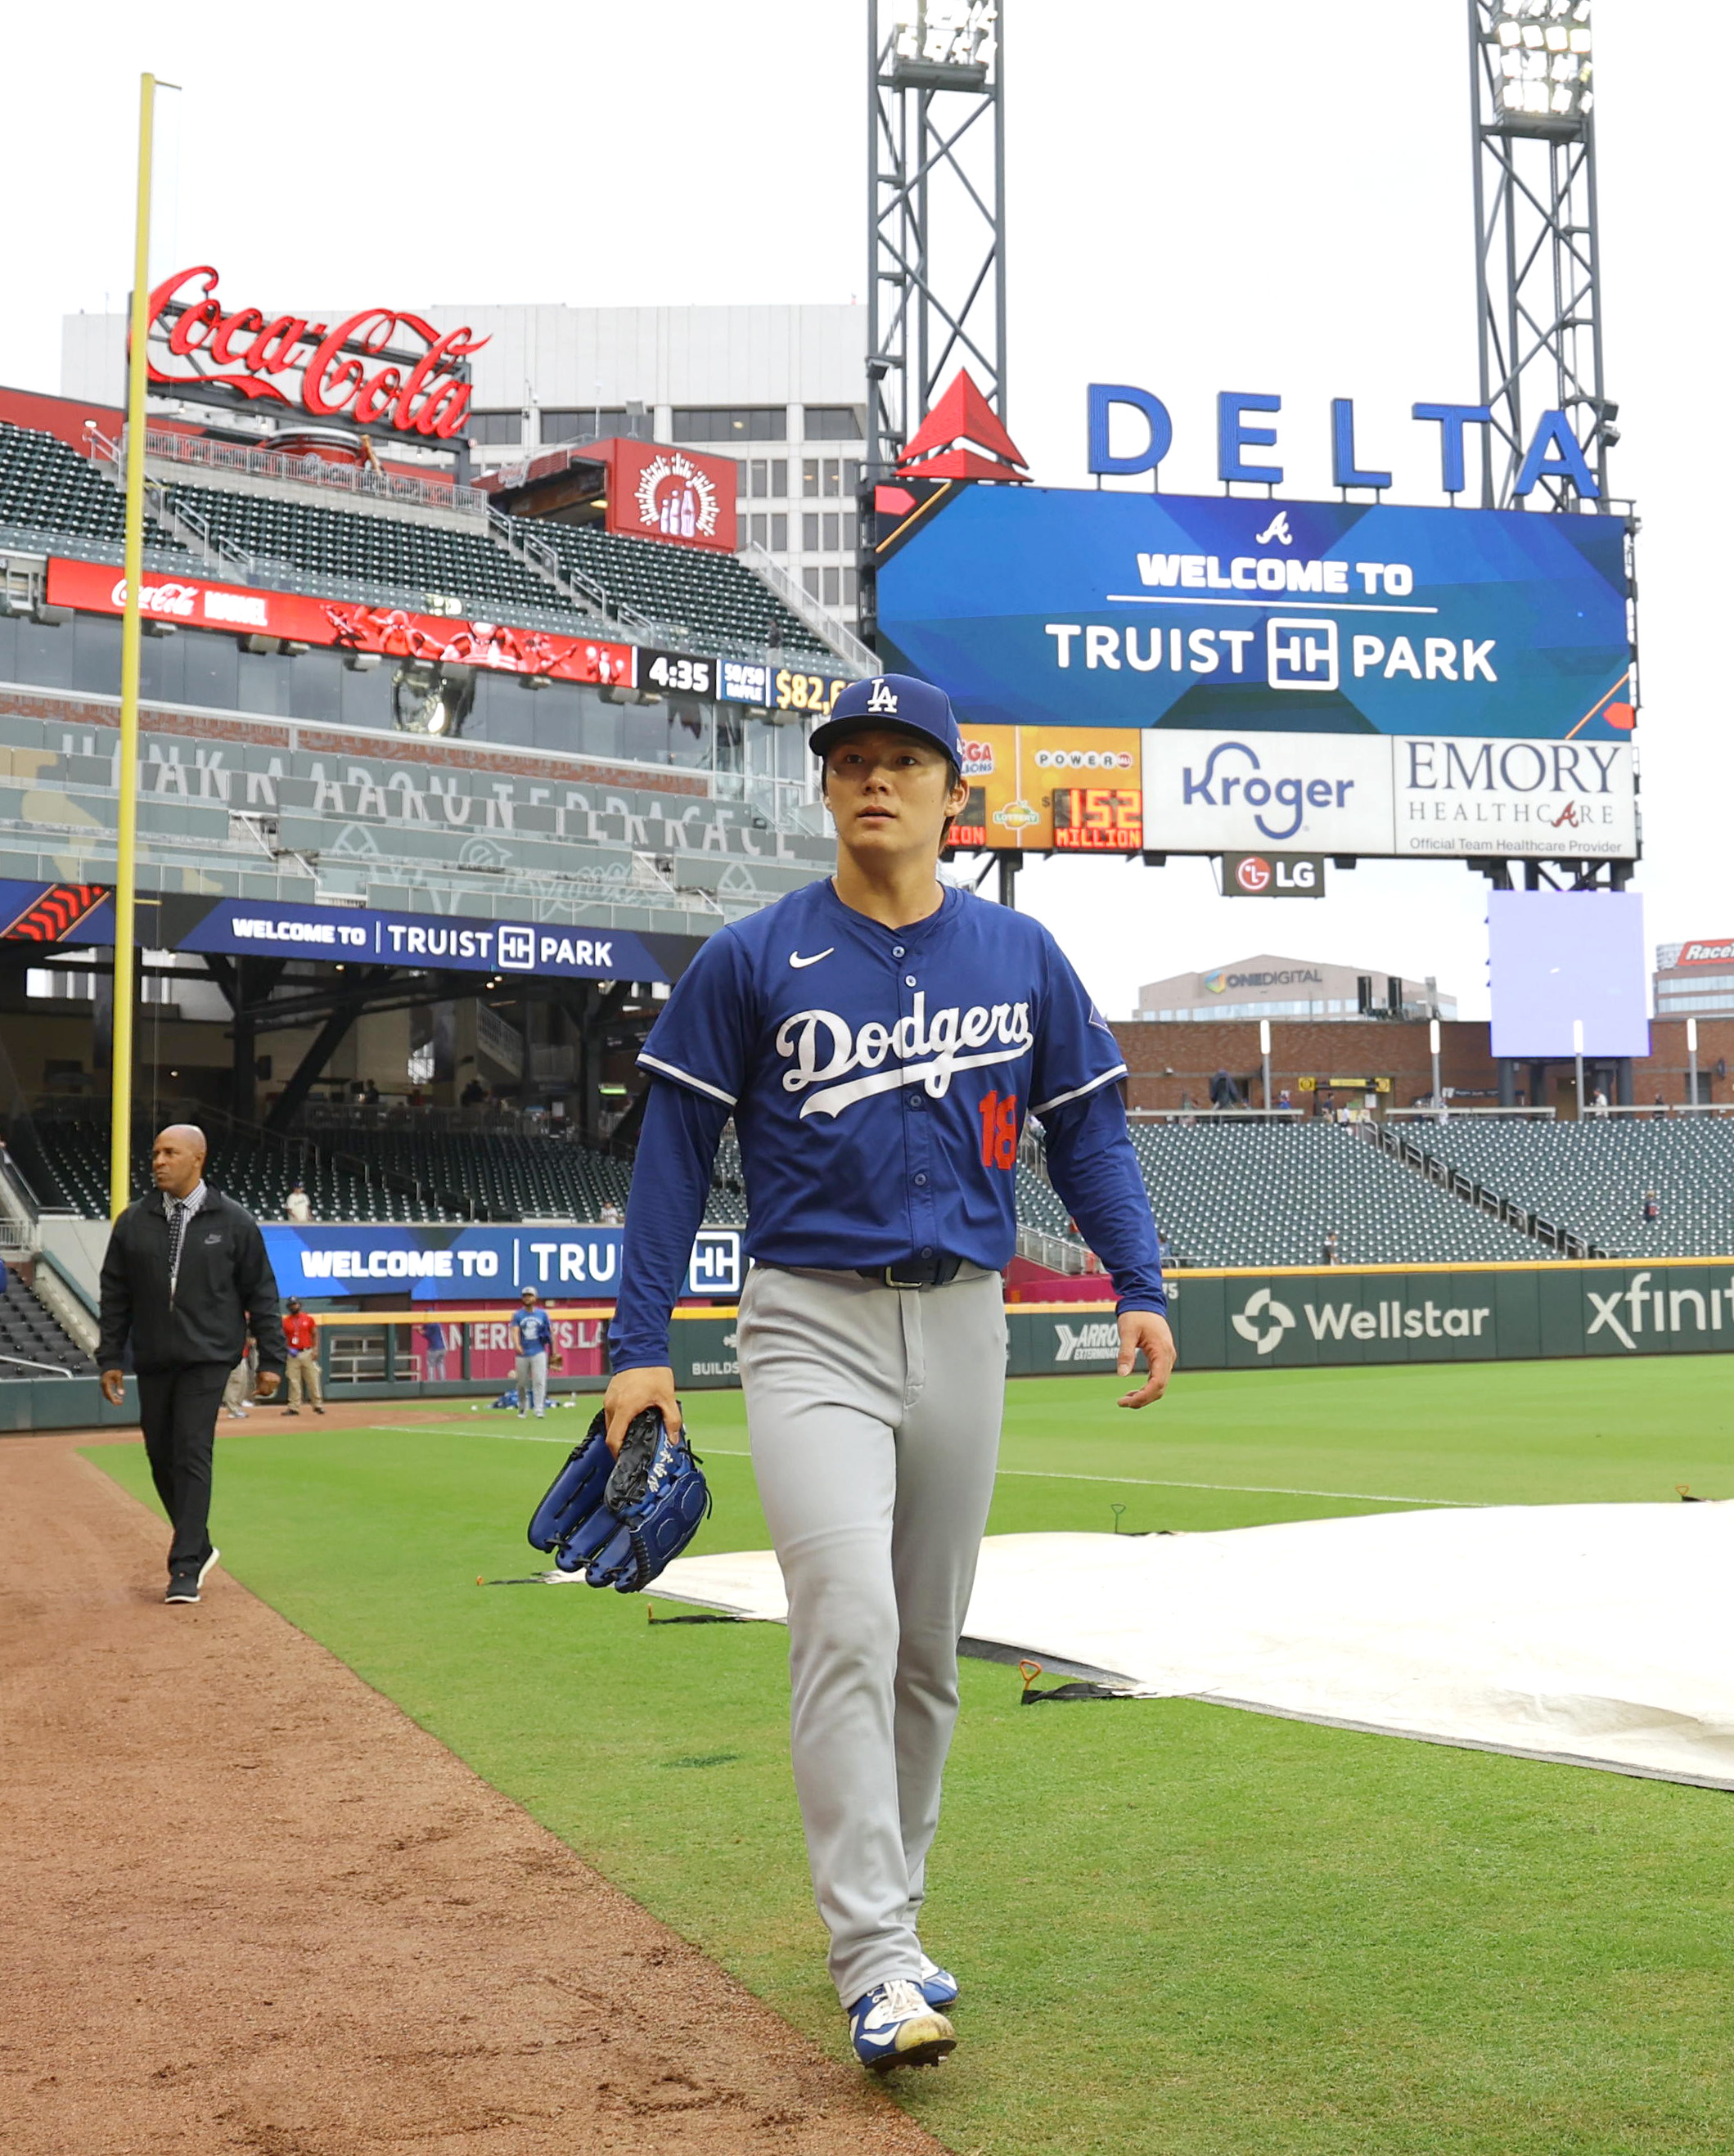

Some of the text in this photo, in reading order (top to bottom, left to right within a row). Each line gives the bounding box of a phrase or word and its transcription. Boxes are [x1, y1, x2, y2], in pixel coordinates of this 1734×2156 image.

[129, 265, 493, 439] Coca-Cola
[1088, 382, 1601, 498] DELTA
[1137, 552, 1412, 595] WELCOME TO
[1045, 623, 1498, 681] TRUIST PARK
[649, 657, 709, 692] 4:35
[724, 663, 765, 685] 50/50
[867, 677, 898, 713] LA
[1405, 740, 1622, 793] EMORY
[1042, 796, 1051, 808] $
[1069, 789, 1142, 829] 152
[1182, 742, 1354, 839] Kroger
[1409, 800, 1613, 827] HEALTHCARE
[1055, 828, 1142, 848] MILLION
[1410, 837, 1622, 853] Official Team Healthcare Provider
[1277, 862, 1315, 888] LG
[232, 918, 613, 967] WELCOME TO TRUIST PARK
[1227, 970, 1322, 988] ONEDIGITAL
[777, 992, 1034, 1098] Dodgers
[980, 1091, 1017, 1170] 18
[301, 1243, 623, 1281] WELCOME TO TRU
[1077, 1324, 1120, 1347] ARRO
[1304, 1301, 1489, 1341] Wellstar
